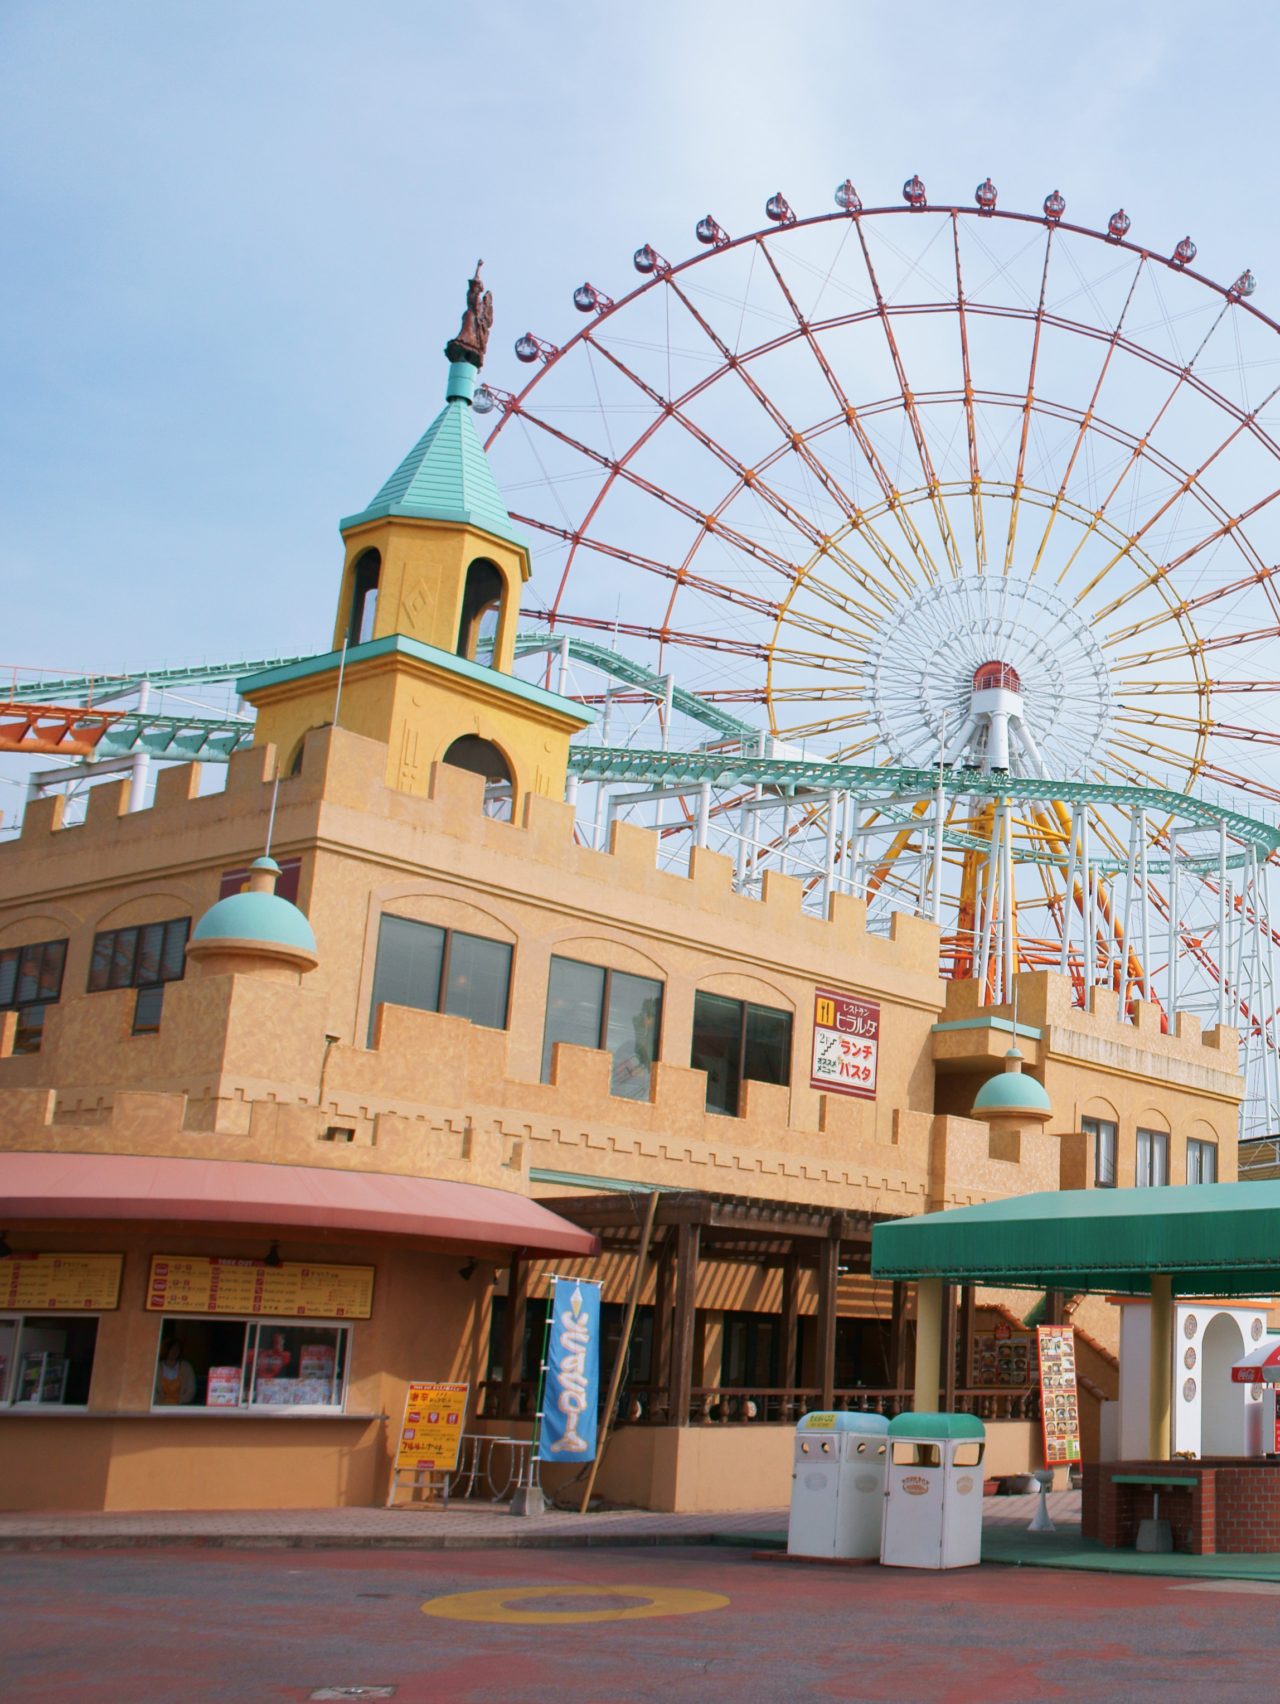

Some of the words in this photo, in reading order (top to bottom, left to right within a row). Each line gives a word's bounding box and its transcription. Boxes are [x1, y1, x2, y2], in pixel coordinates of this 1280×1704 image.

[843, 1003, 869, 1017] レストラン
[836, 1011, 878, 1037] ヒラルダ
[841, 1040, 873, 1060] ランチ
[817, 1057, 836, 1067] オススメ
[817, 1065, 836, 1074] メニュー
[840, 1061, 871, 1081] パスタ
